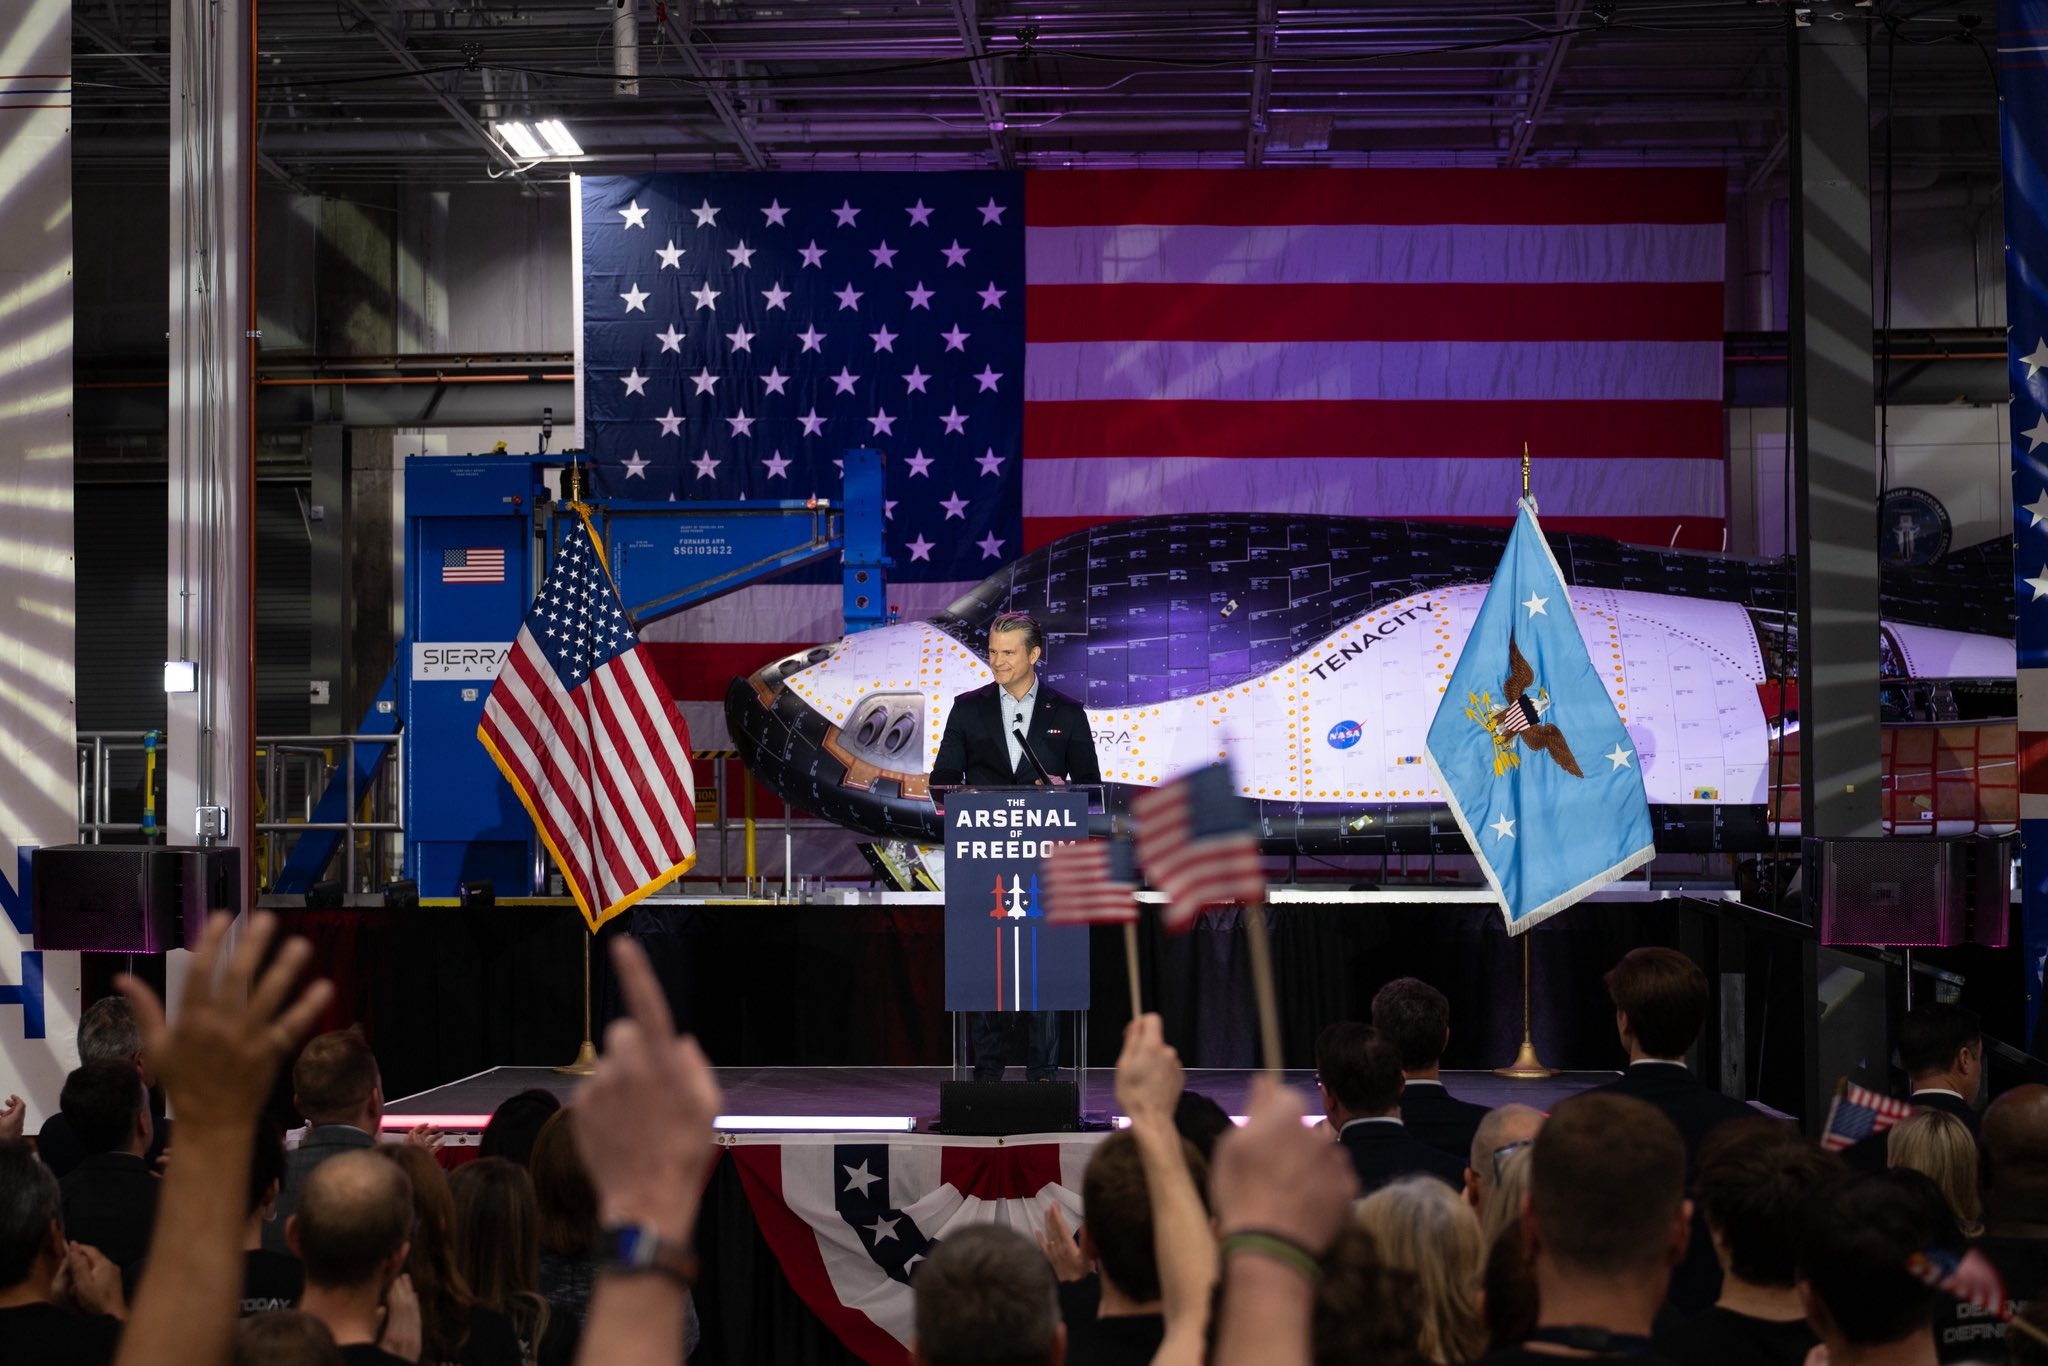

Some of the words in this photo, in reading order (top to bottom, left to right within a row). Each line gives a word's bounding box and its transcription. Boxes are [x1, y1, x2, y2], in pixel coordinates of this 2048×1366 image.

[1309, 601, 1433, 680] TENACITY
[1330, 729, 1361, 741] NASA
[1006, 798, 1026, 807] THE
[956, 809, 1077, 828] ARSENAL
[1009, 830, 1023, 838] OF
[1942, 1322, 2007, 1344] DEFIN
